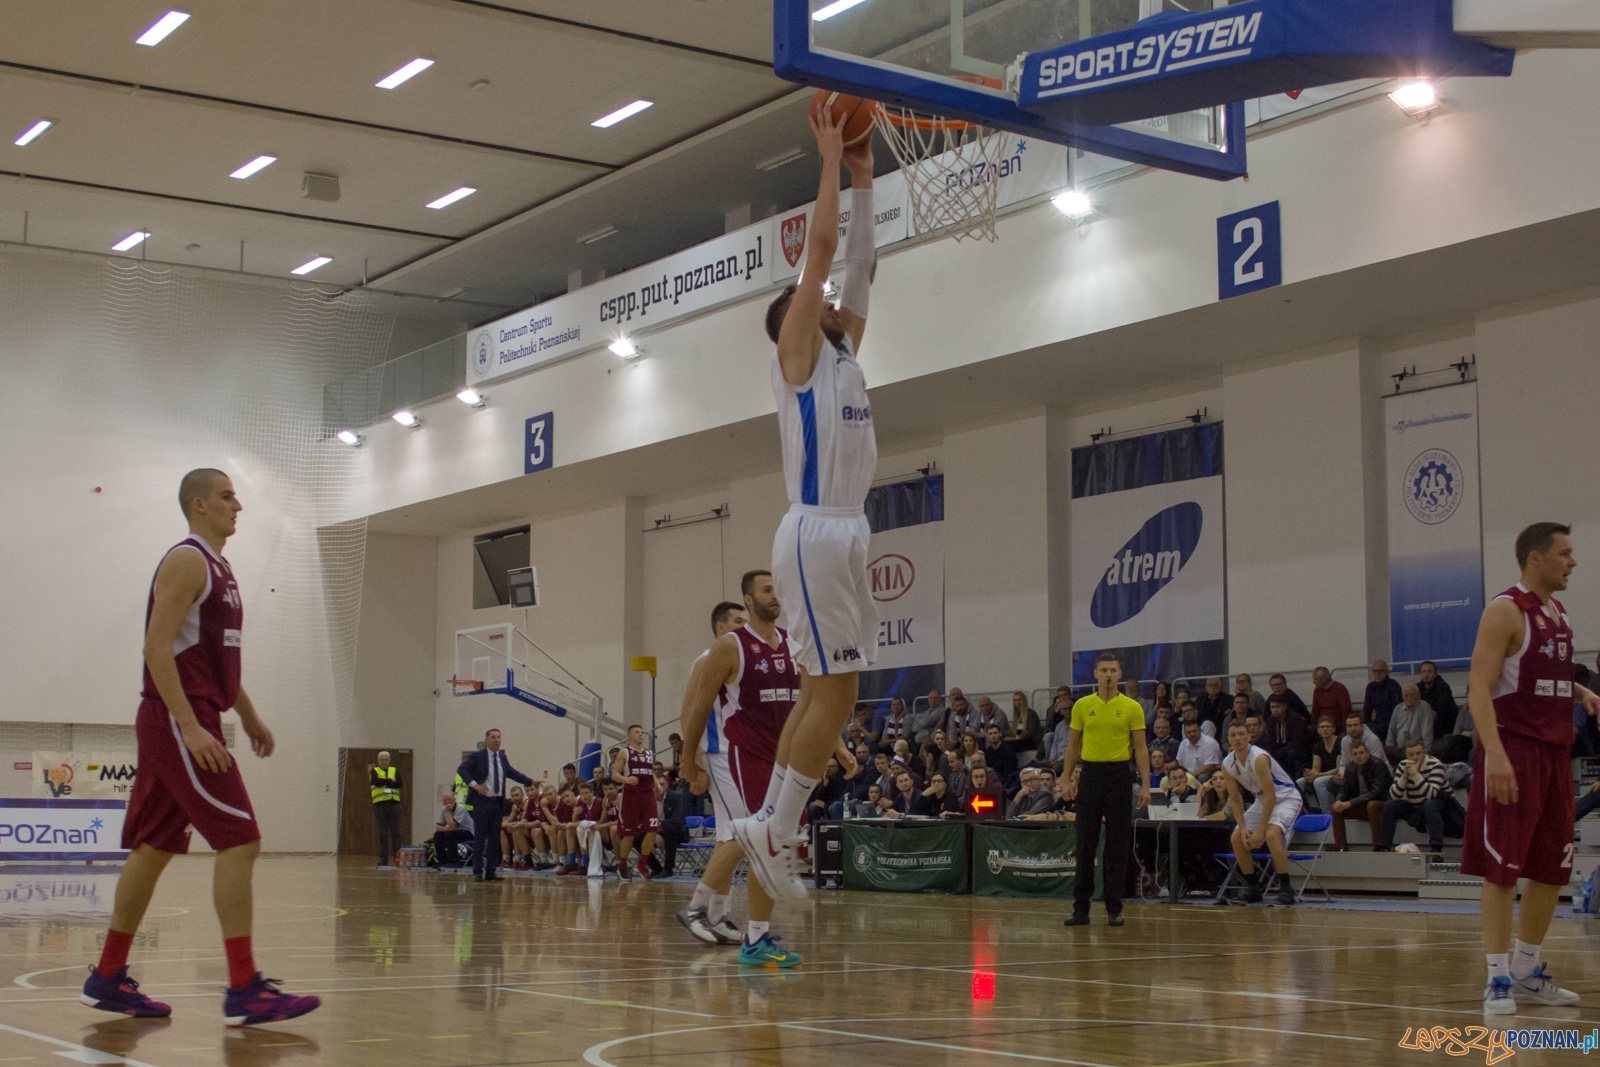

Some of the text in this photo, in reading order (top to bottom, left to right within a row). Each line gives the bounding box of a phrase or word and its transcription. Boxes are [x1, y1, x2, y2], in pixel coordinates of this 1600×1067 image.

[1038, 11, 1263, 87] SPORTSYSTEM
[1233, 216, 1264, 286] 2
[600, 235, 763, 324] cspp.put.poznan.pl
[499, 316, 553, 343] Centrum Sportu
[499, 338, 537, 365] Politechniki
[538, 325, 581, 352] Poznańskiej
[530, 419, 546, 466] 3
[871, 563, 906, 593] KIA
[1107, 549, 1182, 586] atrem
